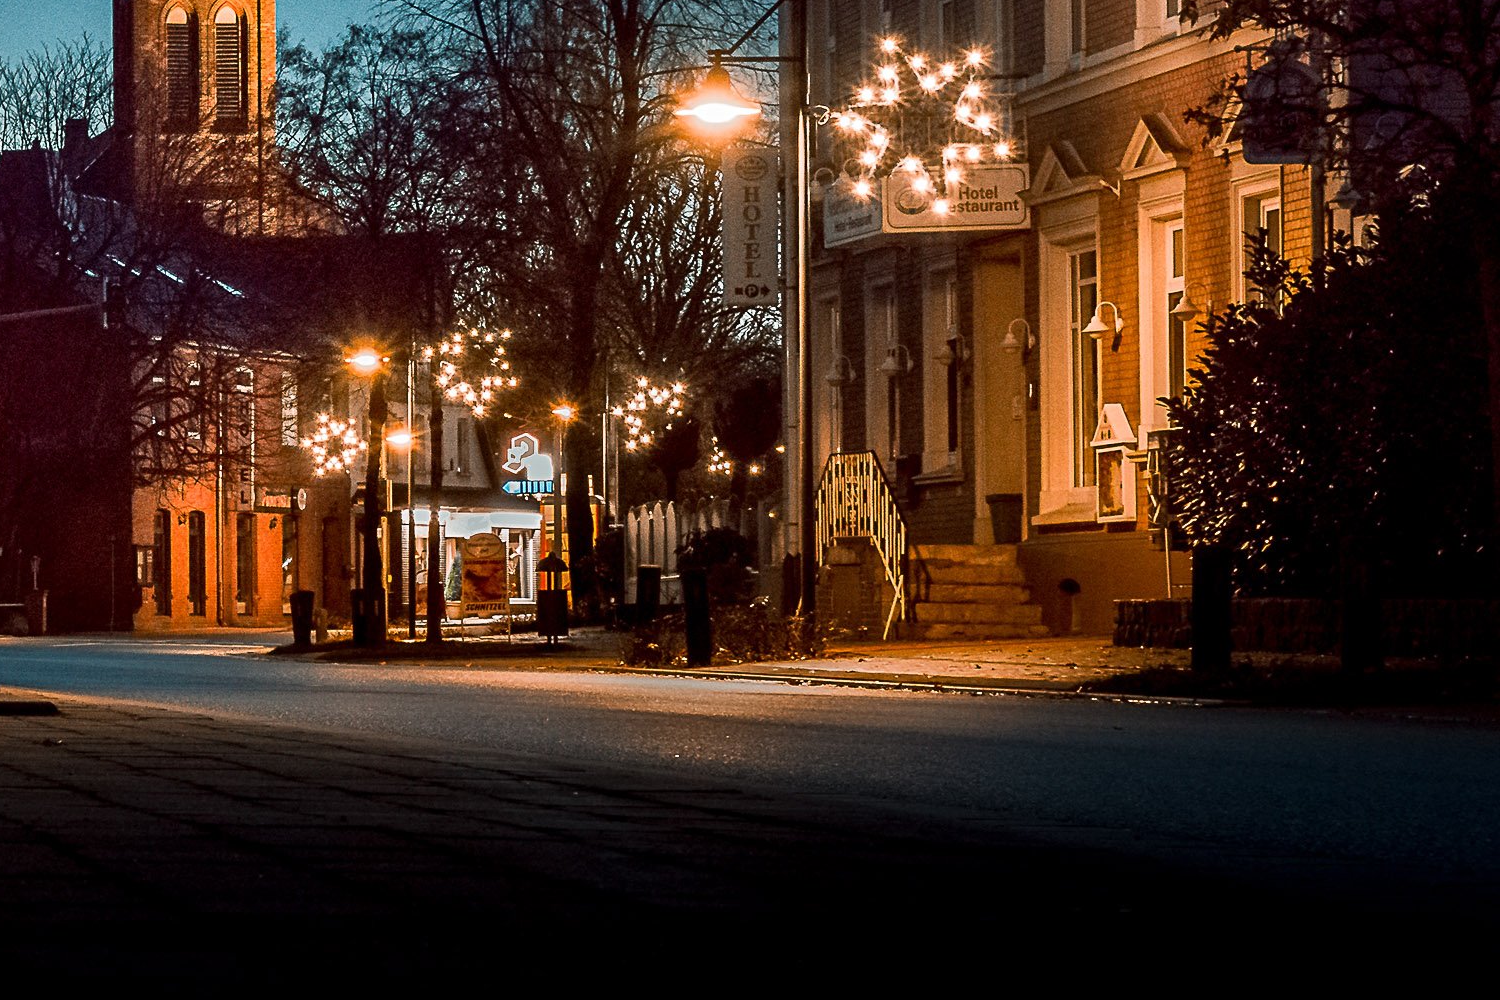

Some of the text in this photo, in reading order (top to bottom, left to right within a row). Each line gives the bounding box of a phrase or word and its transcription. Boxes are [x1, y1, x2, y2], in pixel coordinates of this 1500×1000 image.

[958, 185, 998, 200] Hotel
[945, 199, 1020, 213] estaurant
[743, 186, 761, 278] HOTEL
[465, 602, 506, 611] SCHNITZEL
